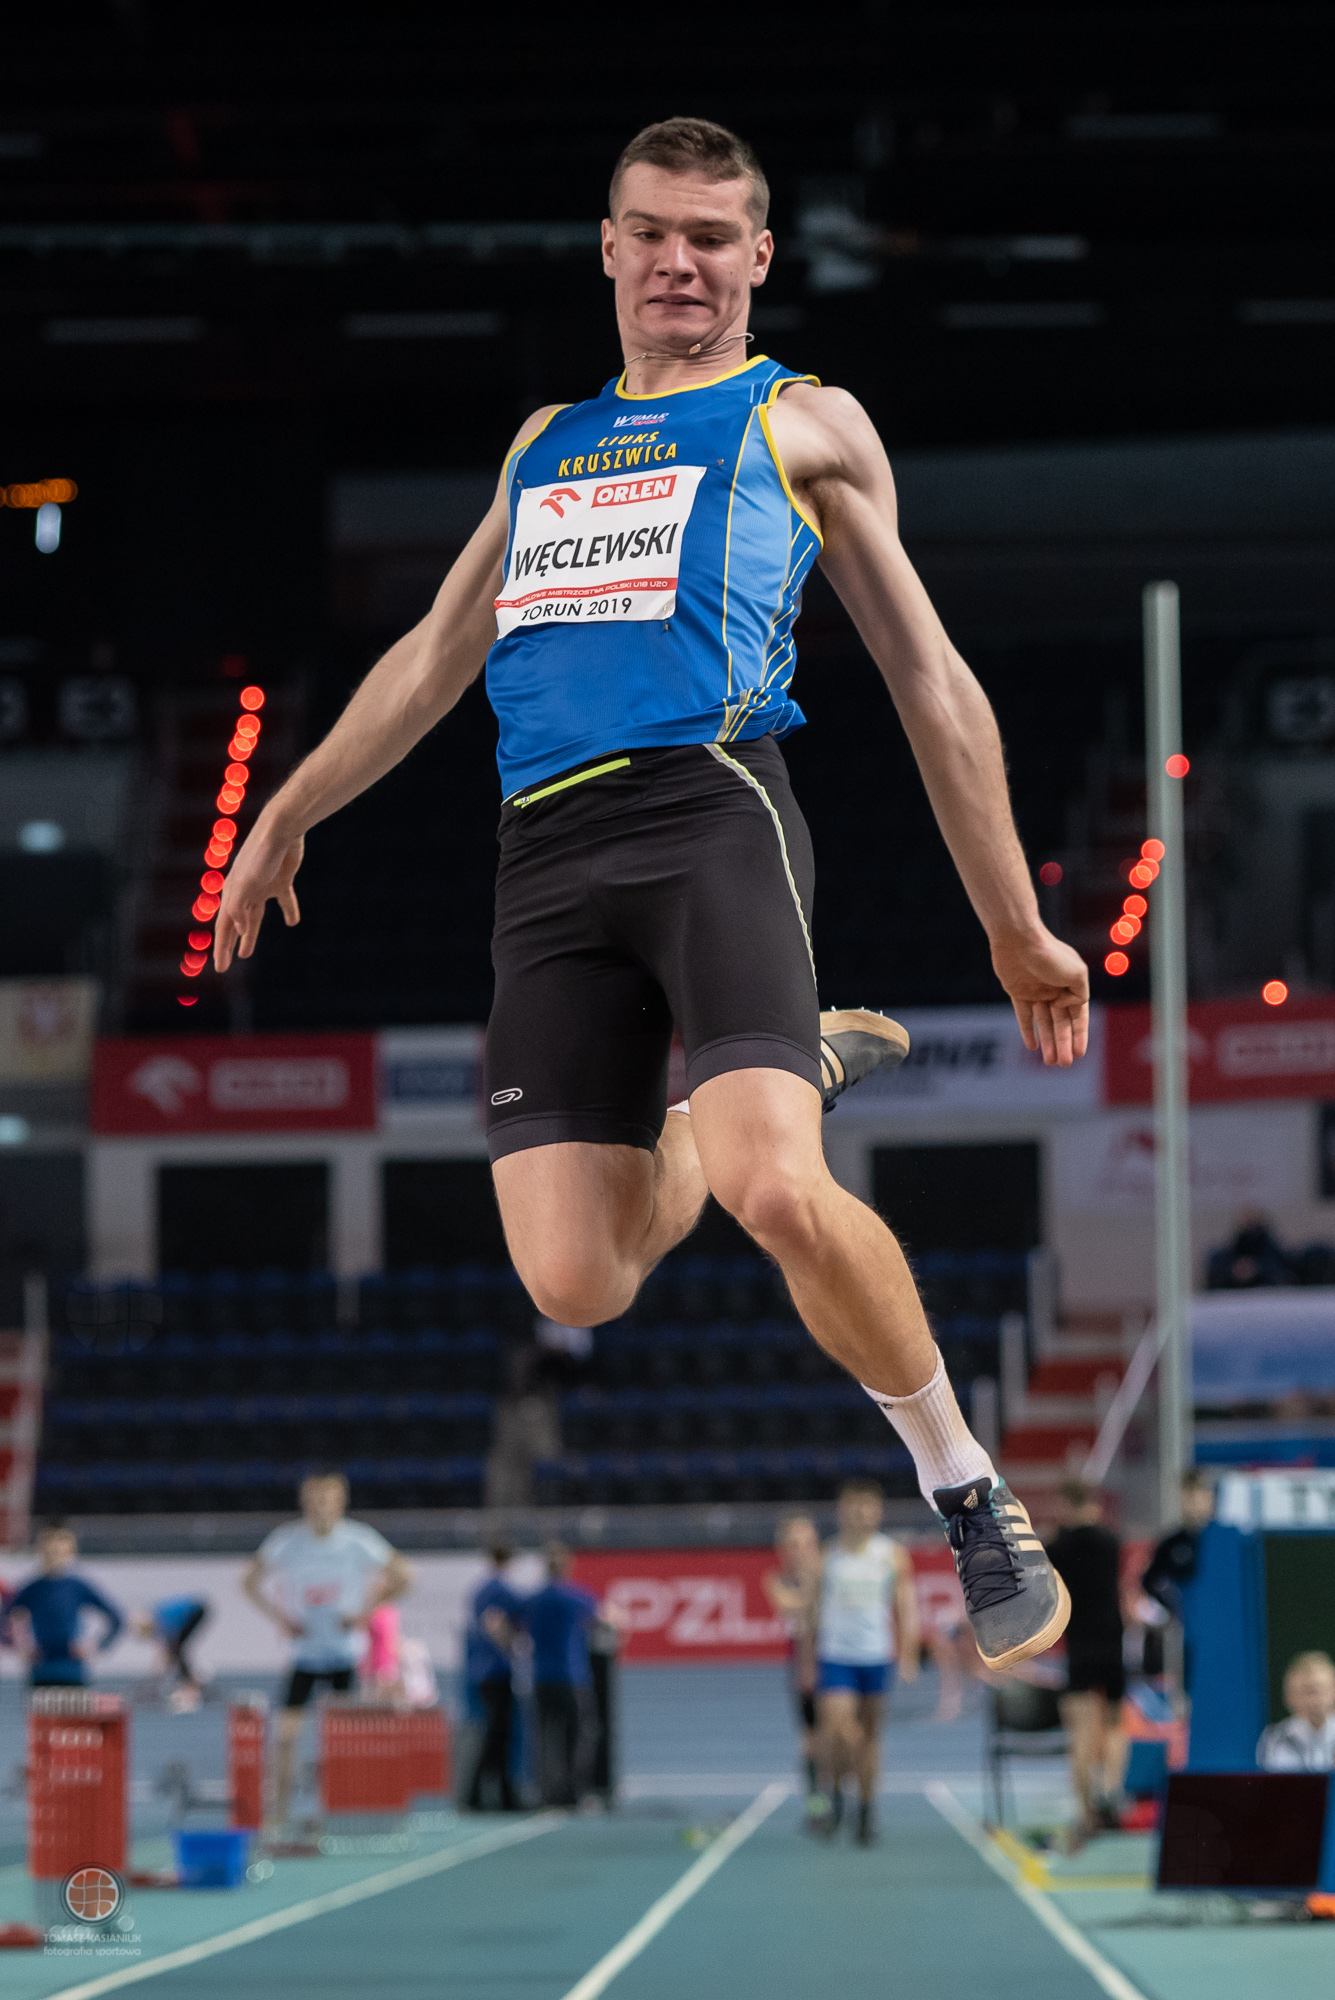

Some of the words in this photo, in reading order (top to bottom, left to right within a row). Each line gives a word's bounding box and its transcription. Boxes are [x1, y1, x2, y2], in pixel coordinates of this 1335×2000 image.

[597, 431, 660, 448] LIUKS
[558, 443, 677, 477] KRUSZWICA
[596, 479, 673, 503] ORLEN
[515, 523, 678, 581] WĘCLEWSKI
[520, 591, 546, 605] HALOWE
[547, 587, 604, 597] MISTRZOSTWA
[605, 582, 632, 592] POLSKI
[649, 580, 668, 588] U20
[521, 599, 582, 621] TORUŃ
[586, 597, 632, 617] 2019
